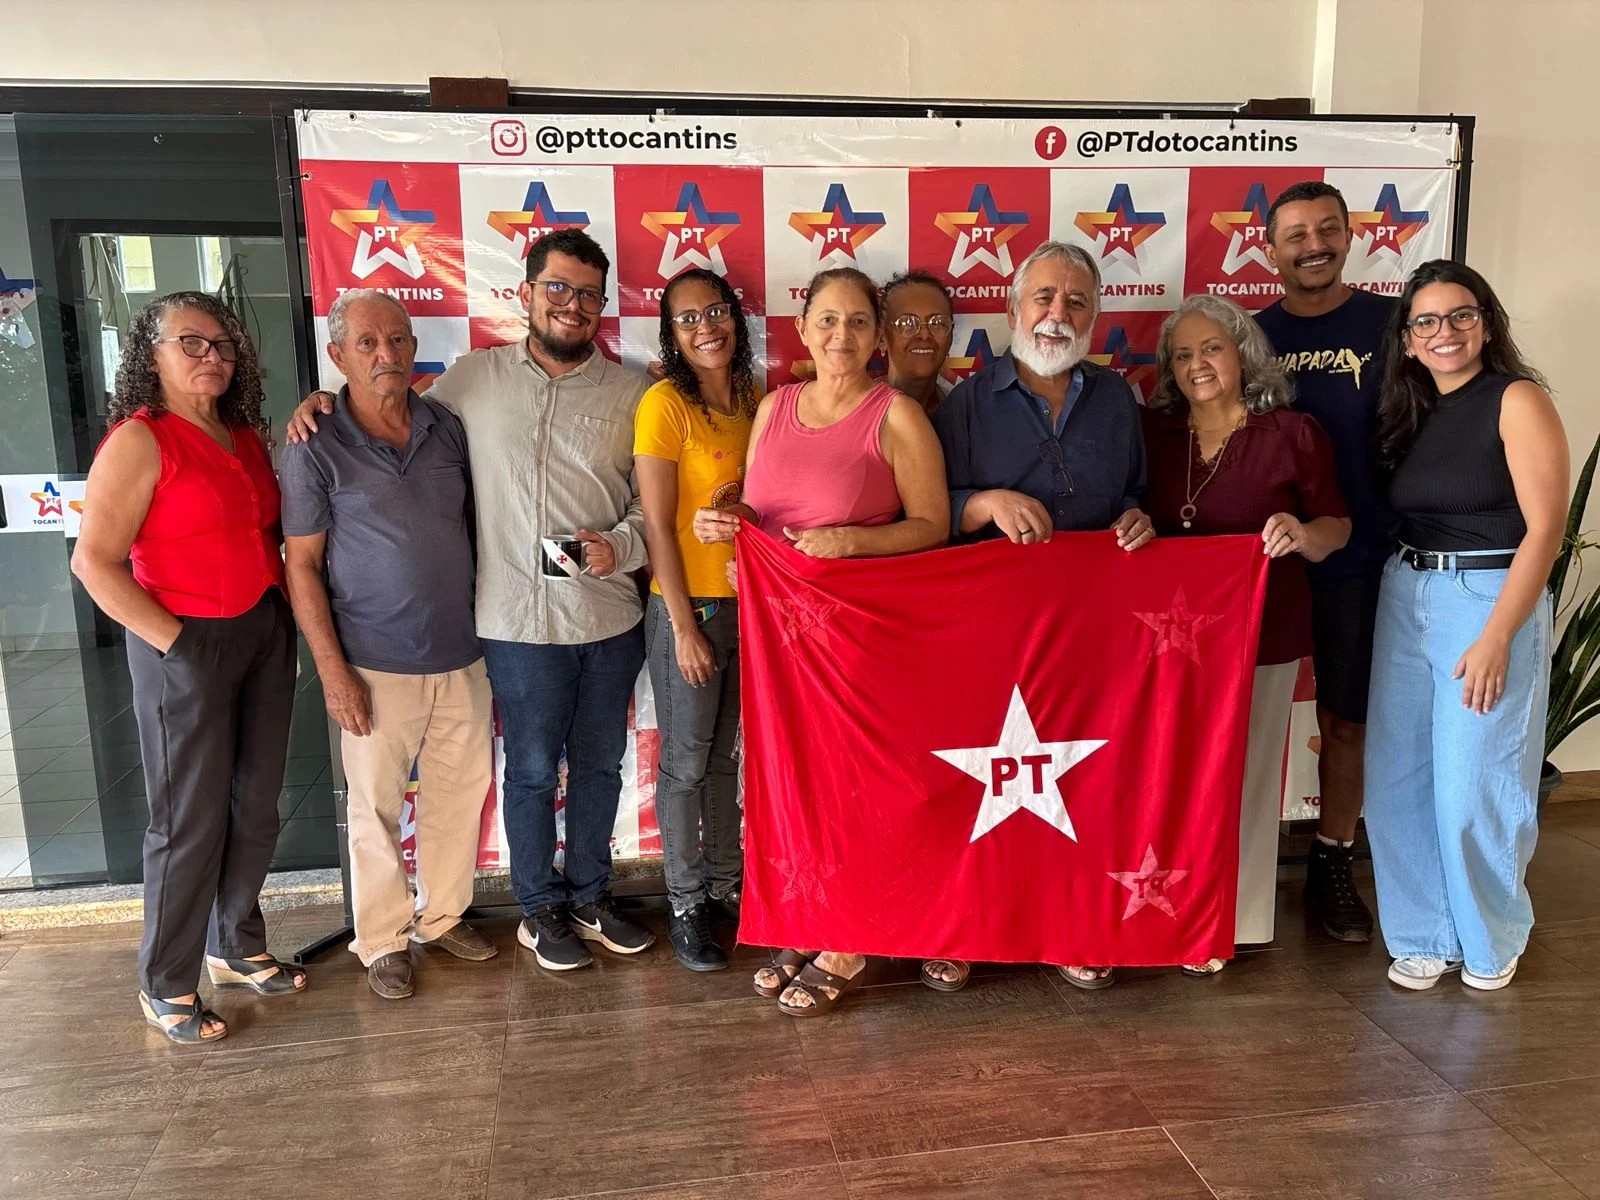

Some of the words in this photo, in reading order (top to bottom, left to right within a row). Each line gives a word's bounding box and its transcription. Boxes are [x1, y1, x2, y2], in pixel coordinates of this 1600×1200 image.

[535, 125, 738, 153] @pttocantins
[1076, 129, 1298, 158] @PTdotocantins
[373, 226, 400, 242] PT
[680, 228, 705, 243] PT
[826, 228, 851, 243] PT
[971, 227, 995, 242] PT
[1109, 227, 1133, 242] PT
[1244, 226, 1266, 241] PT
[1375, 226, 1398, 240] PT
[945, 286, 1012, 298] OCANTI
[1206, 283, 1286, 295] TOCANTIN
[1272, 348, 1351, 372] HAPADA
[991, 754, 1052, 796] PT
